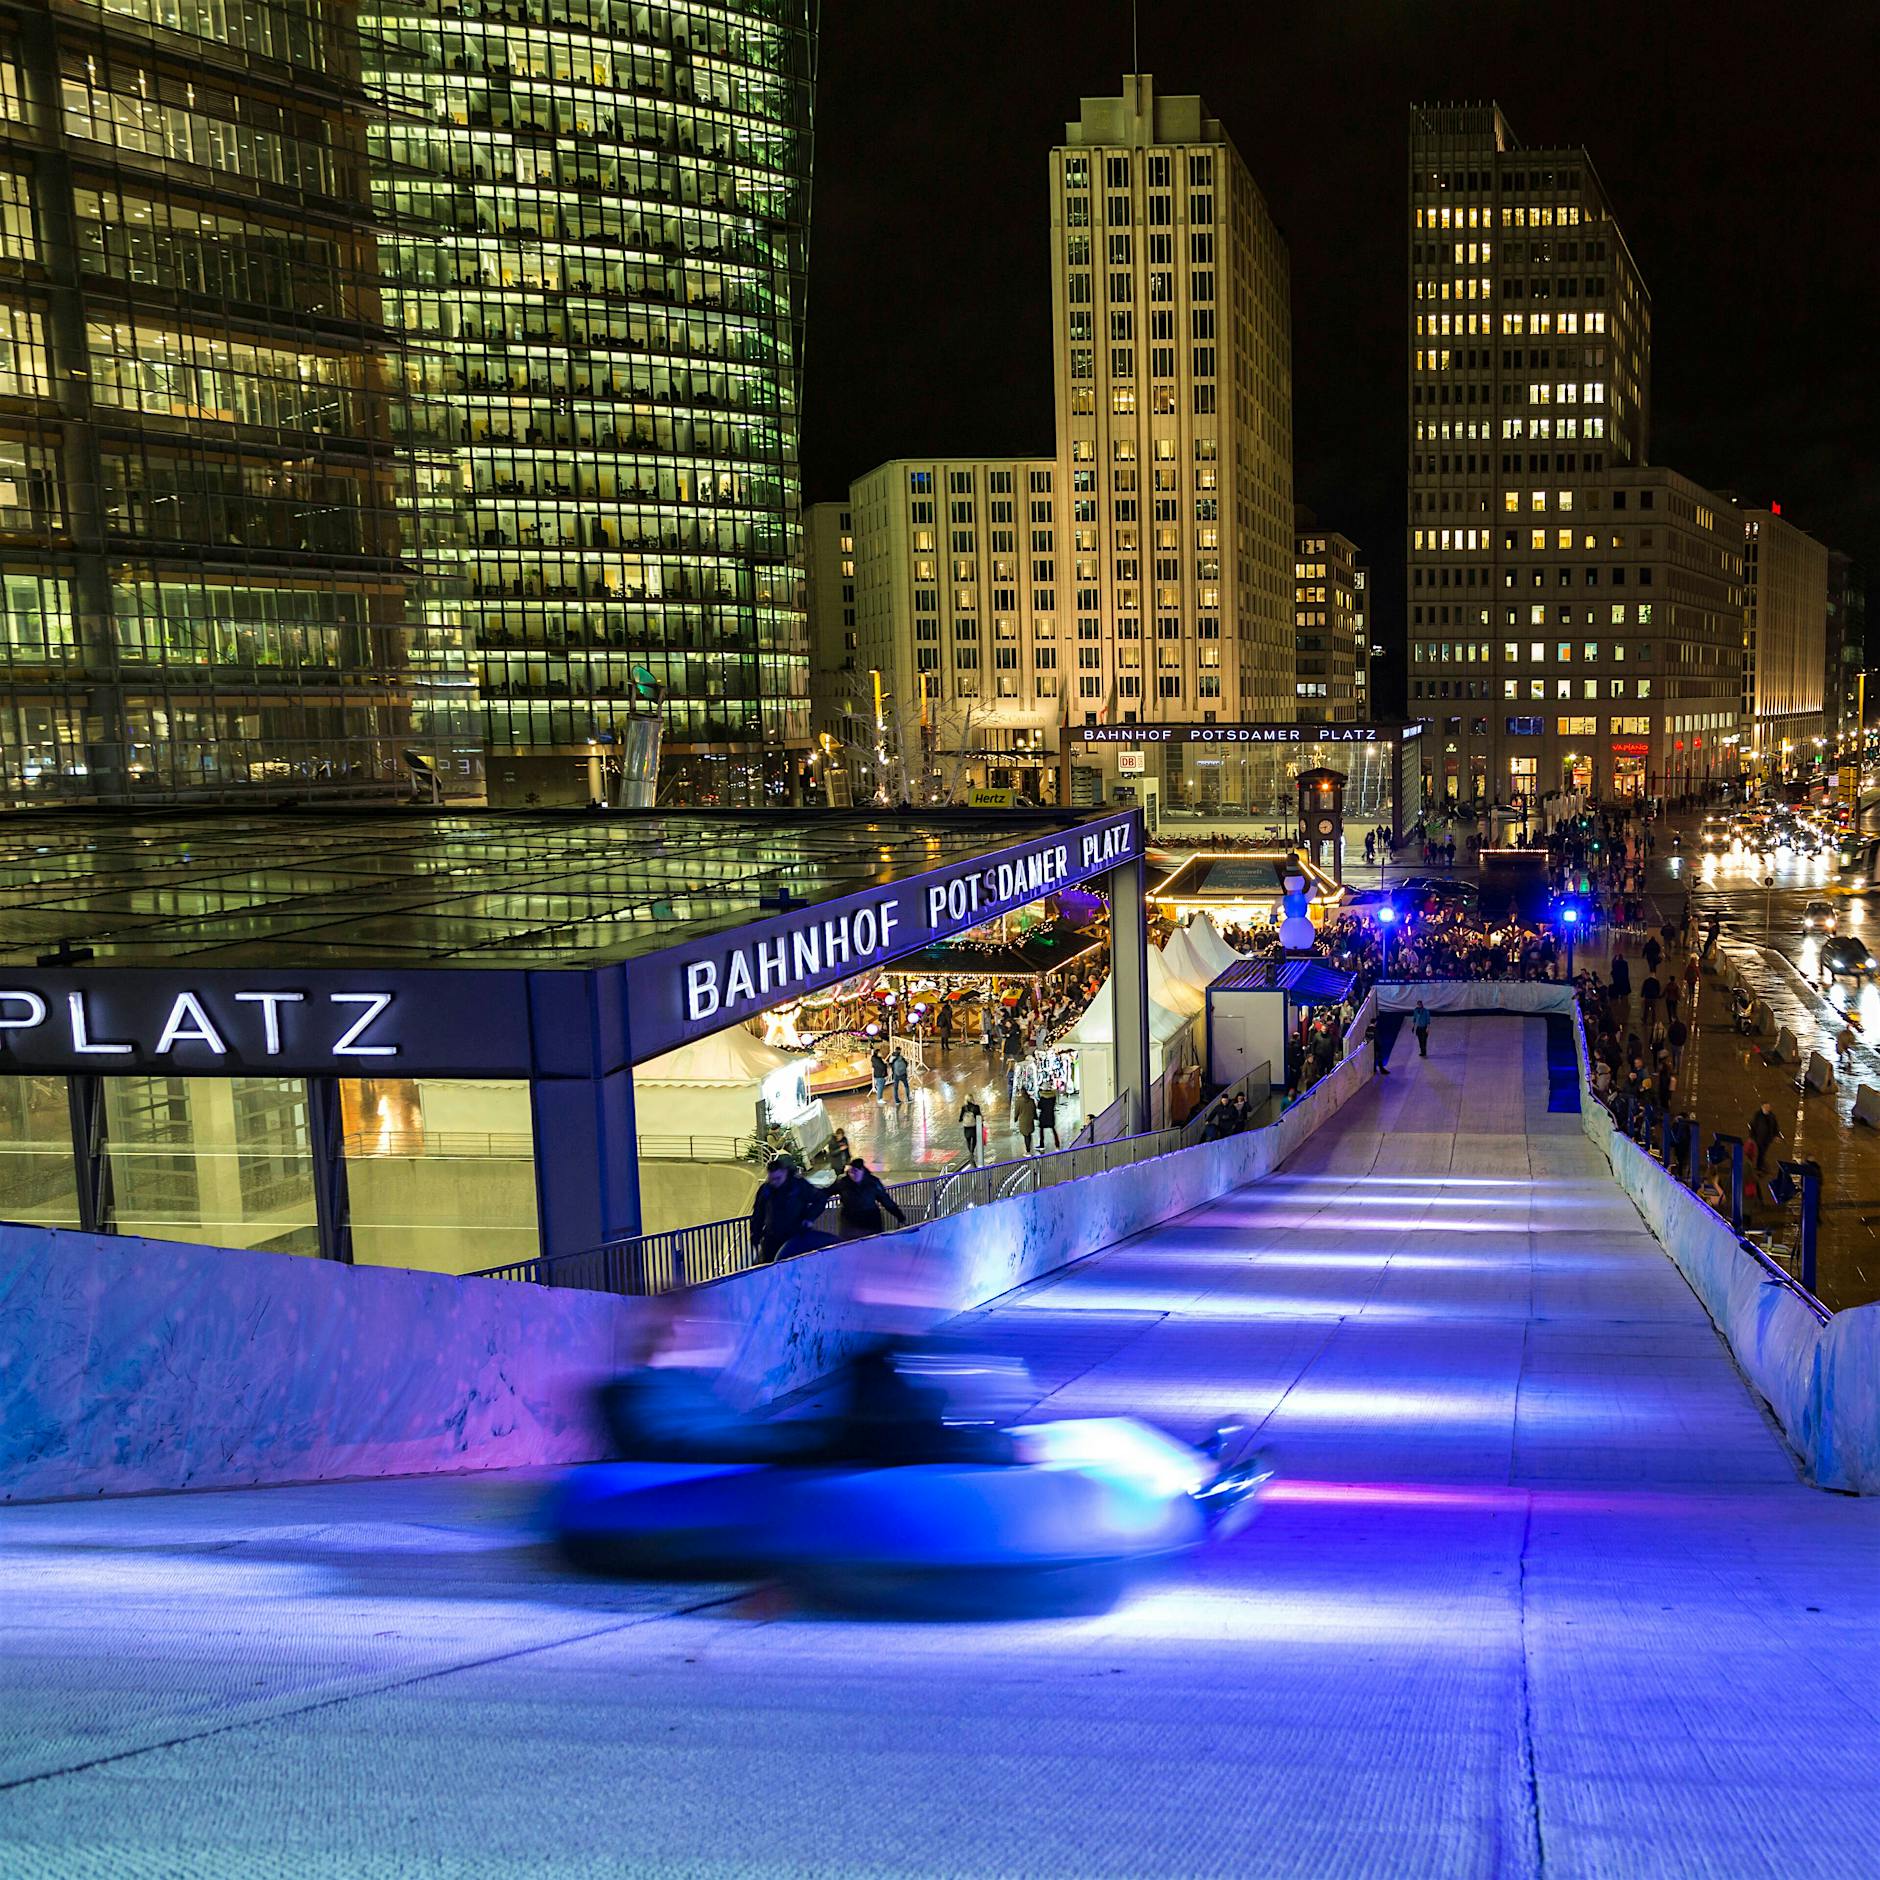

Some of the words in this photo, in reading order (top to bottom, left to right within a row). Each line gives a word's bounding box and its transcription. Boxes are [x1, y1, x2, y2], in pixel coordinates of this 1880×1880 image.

[1084, 730, 1172, 741] BAHNHOF
[1190, 730, 1300, 741] POTSDAMER
[1319, 729, 1376, 740] PLATZ
[1122, 757, 1134, 767] DB
[975, 793, 1006, 803] Hertz
[685, 900, 899, 1021] BAHNHOF
[928, 844, 1068, 929] POTSDAMER
[1082, 823, 1131, 868] PLATZ
[0, 990, 398, 1056] PLATZ
